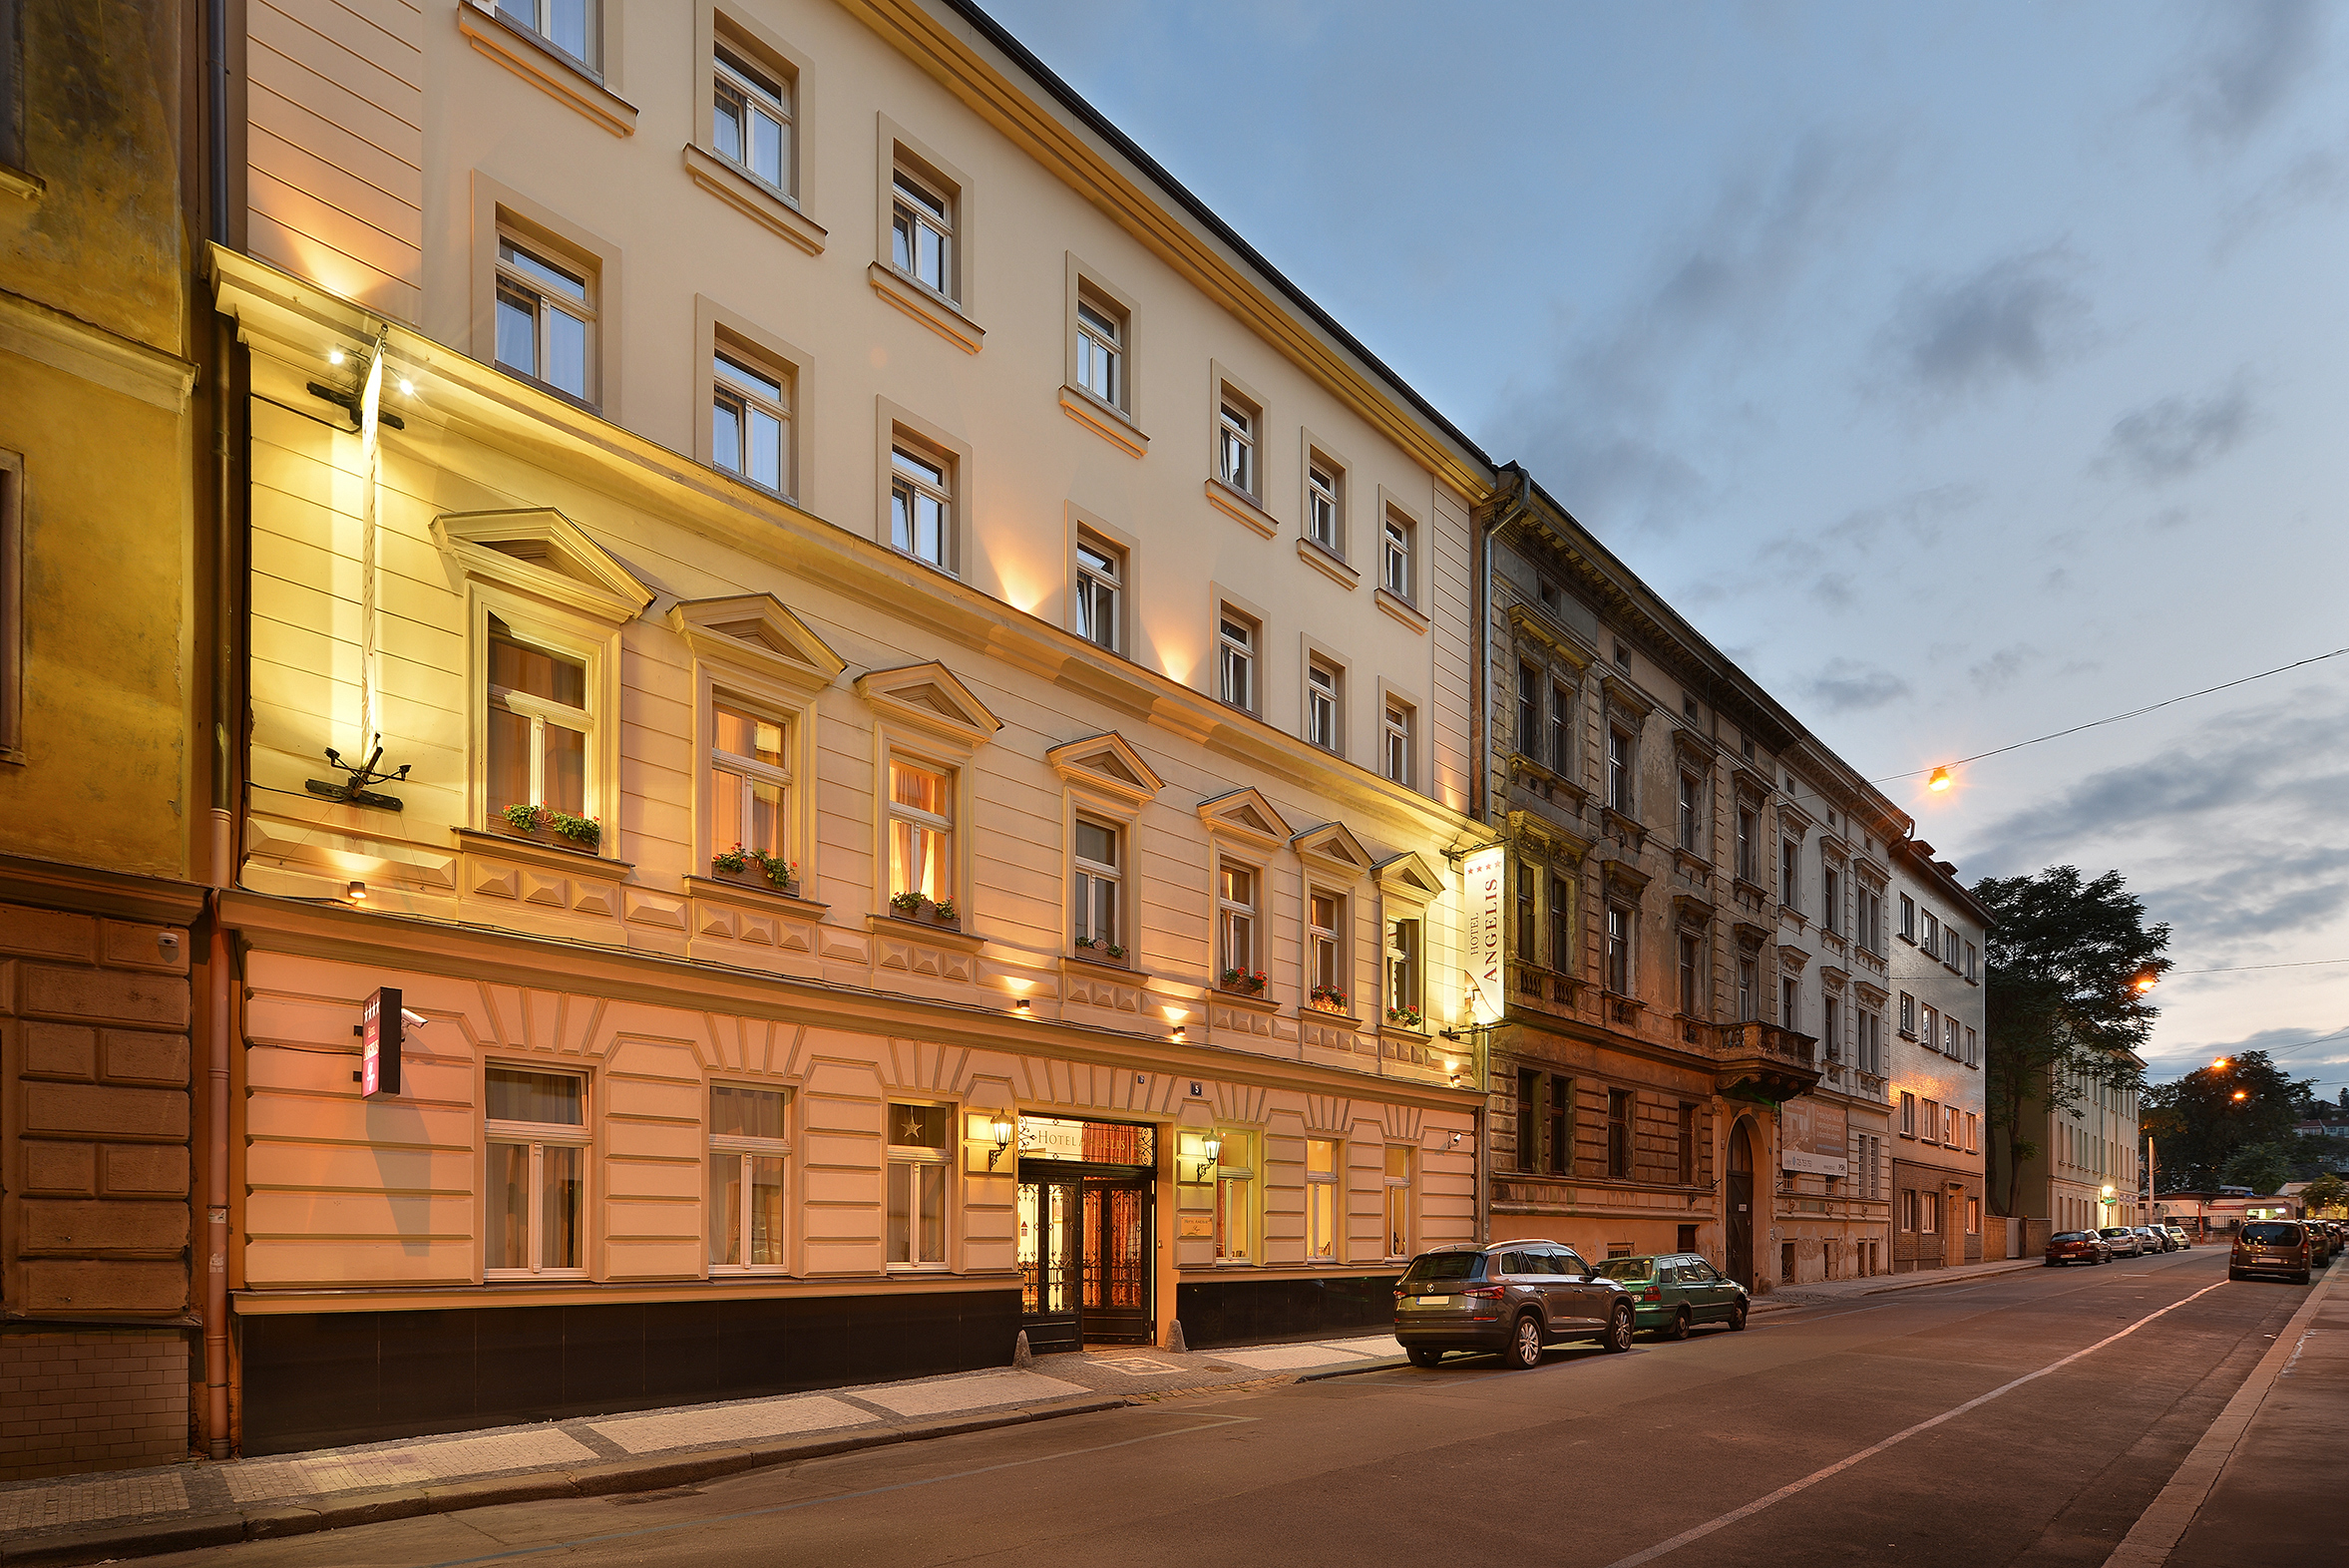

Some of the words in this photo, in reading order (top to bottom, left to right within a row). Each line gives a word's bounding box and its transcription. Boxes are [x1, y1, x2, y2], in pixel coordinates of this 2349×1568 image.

[1470, 912, 1479, 956] HOTEL
[1483, 878, 1498, 983] ANGELIS
[1038, 1130, 1076, 1146] HOTEL
